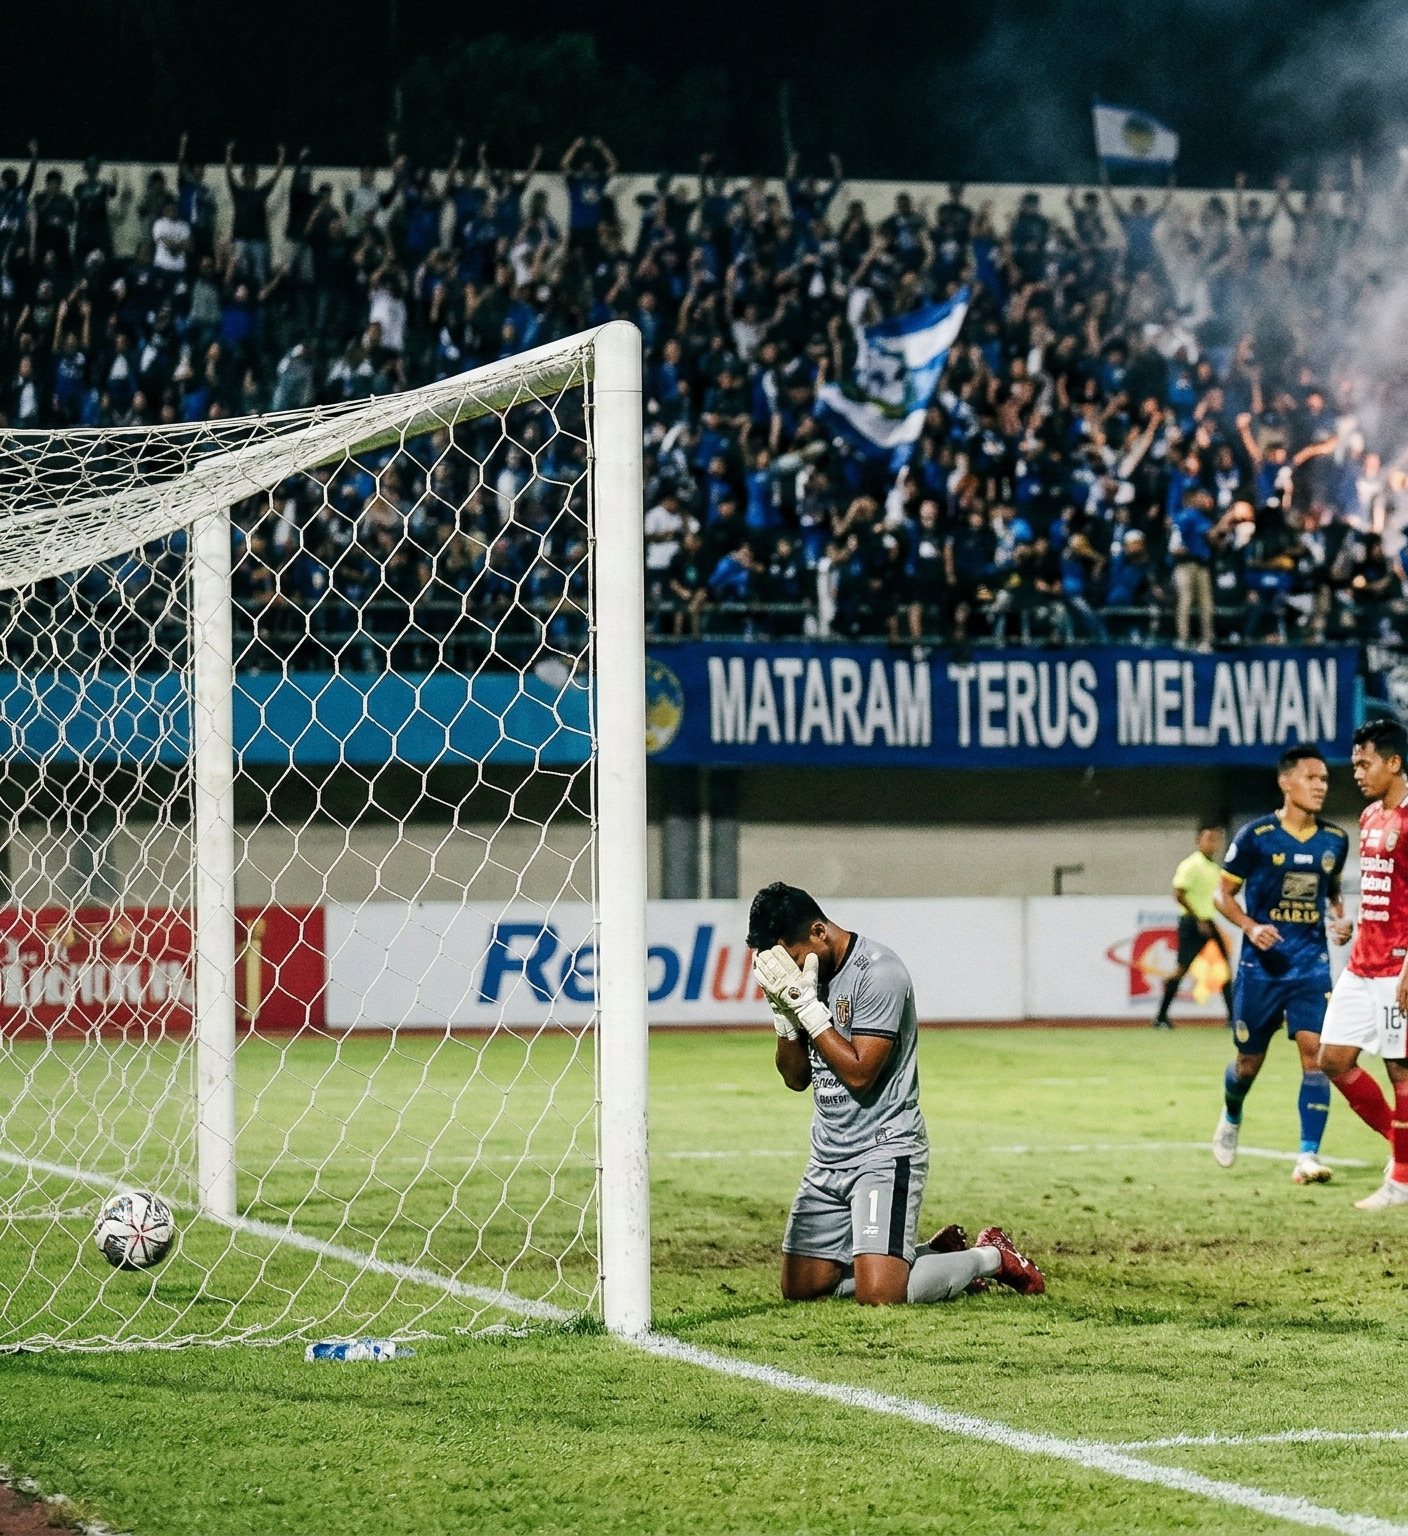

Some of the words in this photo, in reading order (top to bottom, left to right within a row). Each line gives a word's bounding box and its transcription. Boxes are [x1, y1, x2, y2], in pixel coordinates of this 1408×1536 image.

[708, 657, 932, 747] MATARAM
[947, 659, 1099, 748] TERUS
[1117, 658, 1337, 747] MELAWAN
[868, 1189, 879, 1223] 1
